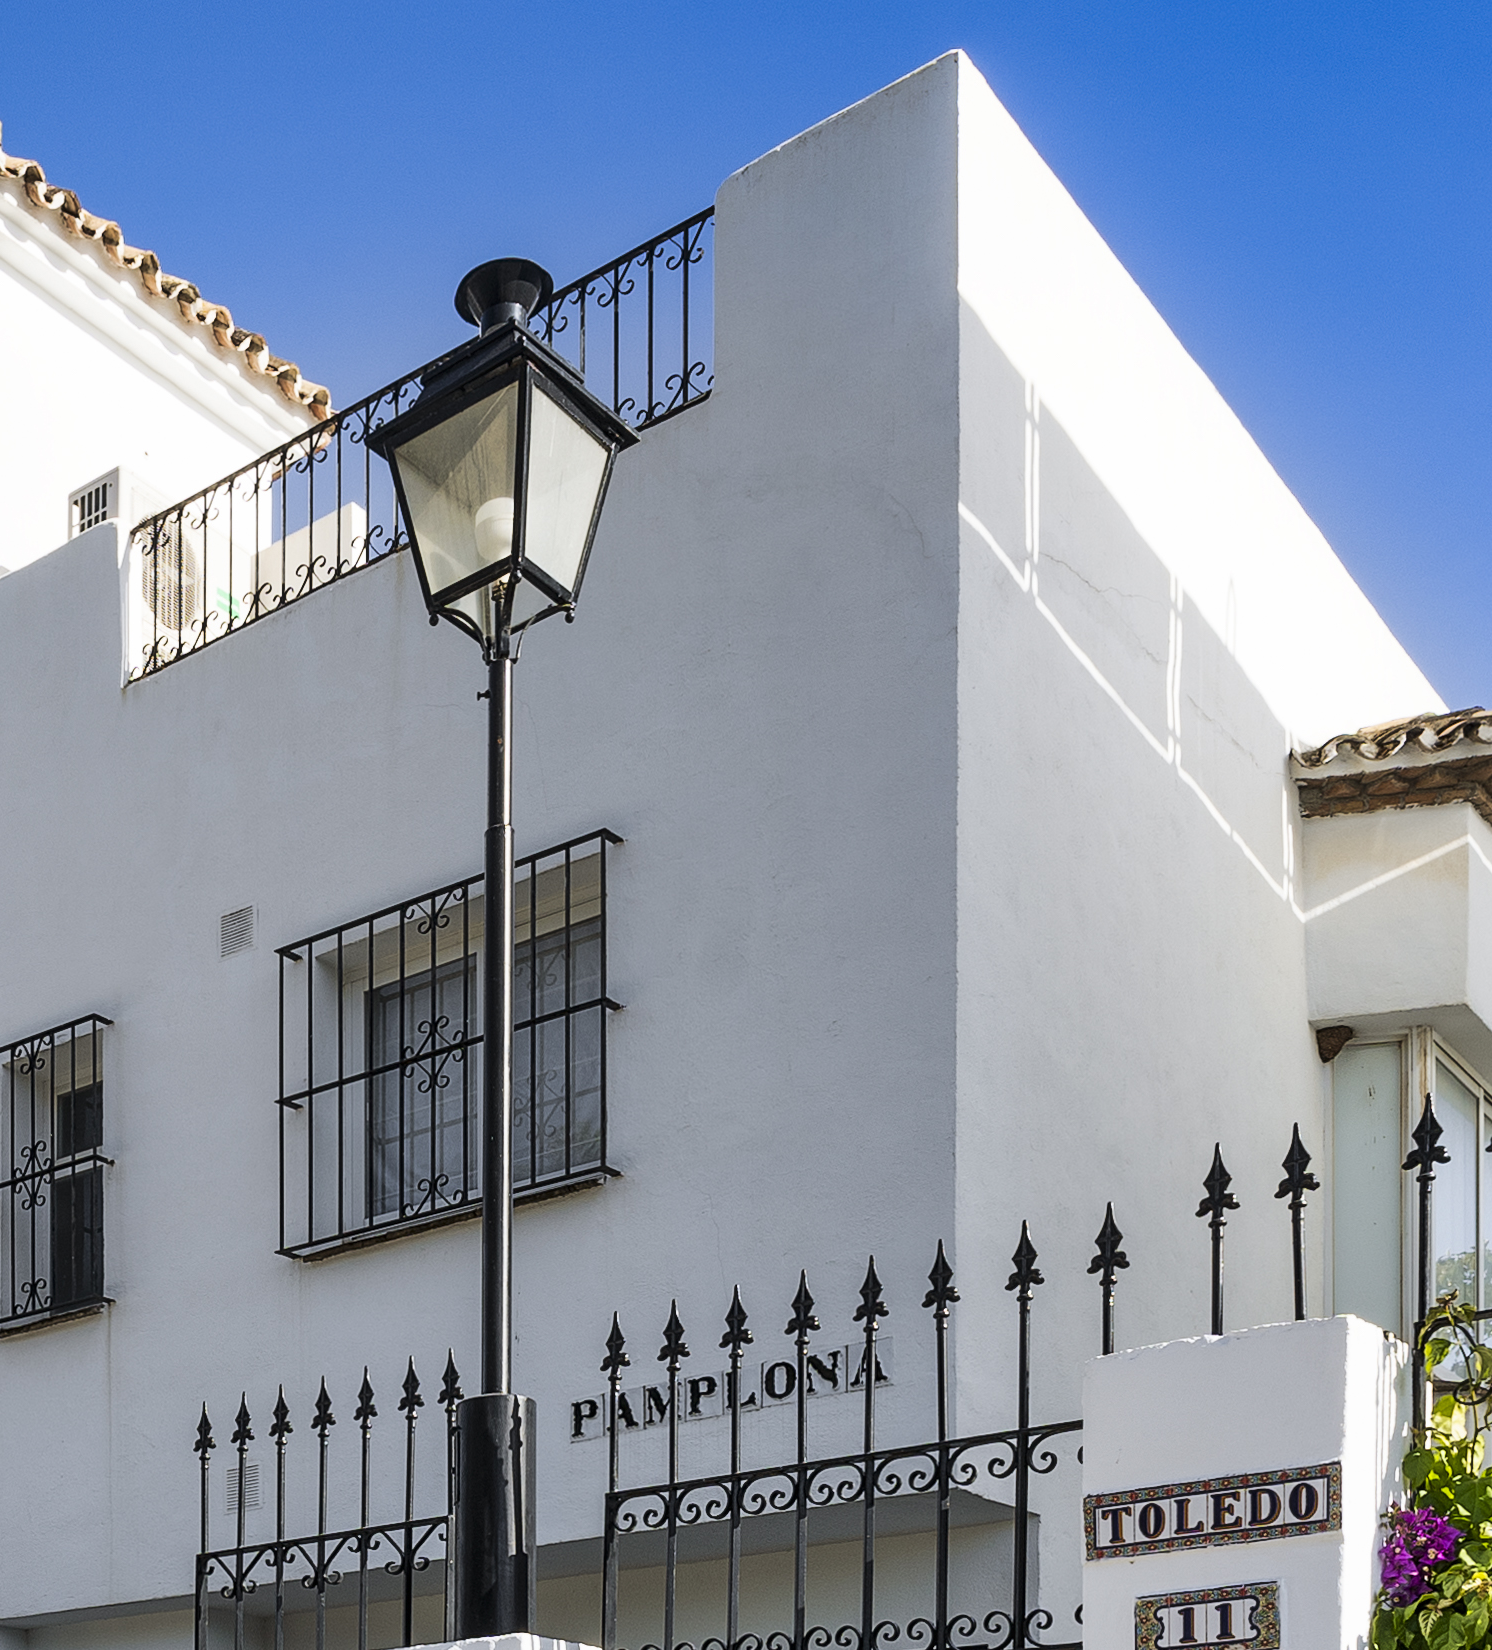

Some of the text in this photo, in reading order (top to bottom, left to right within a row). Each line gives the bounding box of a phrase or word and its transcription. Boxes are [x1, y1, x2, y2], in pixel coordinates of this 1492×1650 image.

[571, 1344, 889, 1438] PAMPLONA
[1101, 1482, 1319, 1544] TOLEDO
[1177, 1602, 1236, 1644] 11
